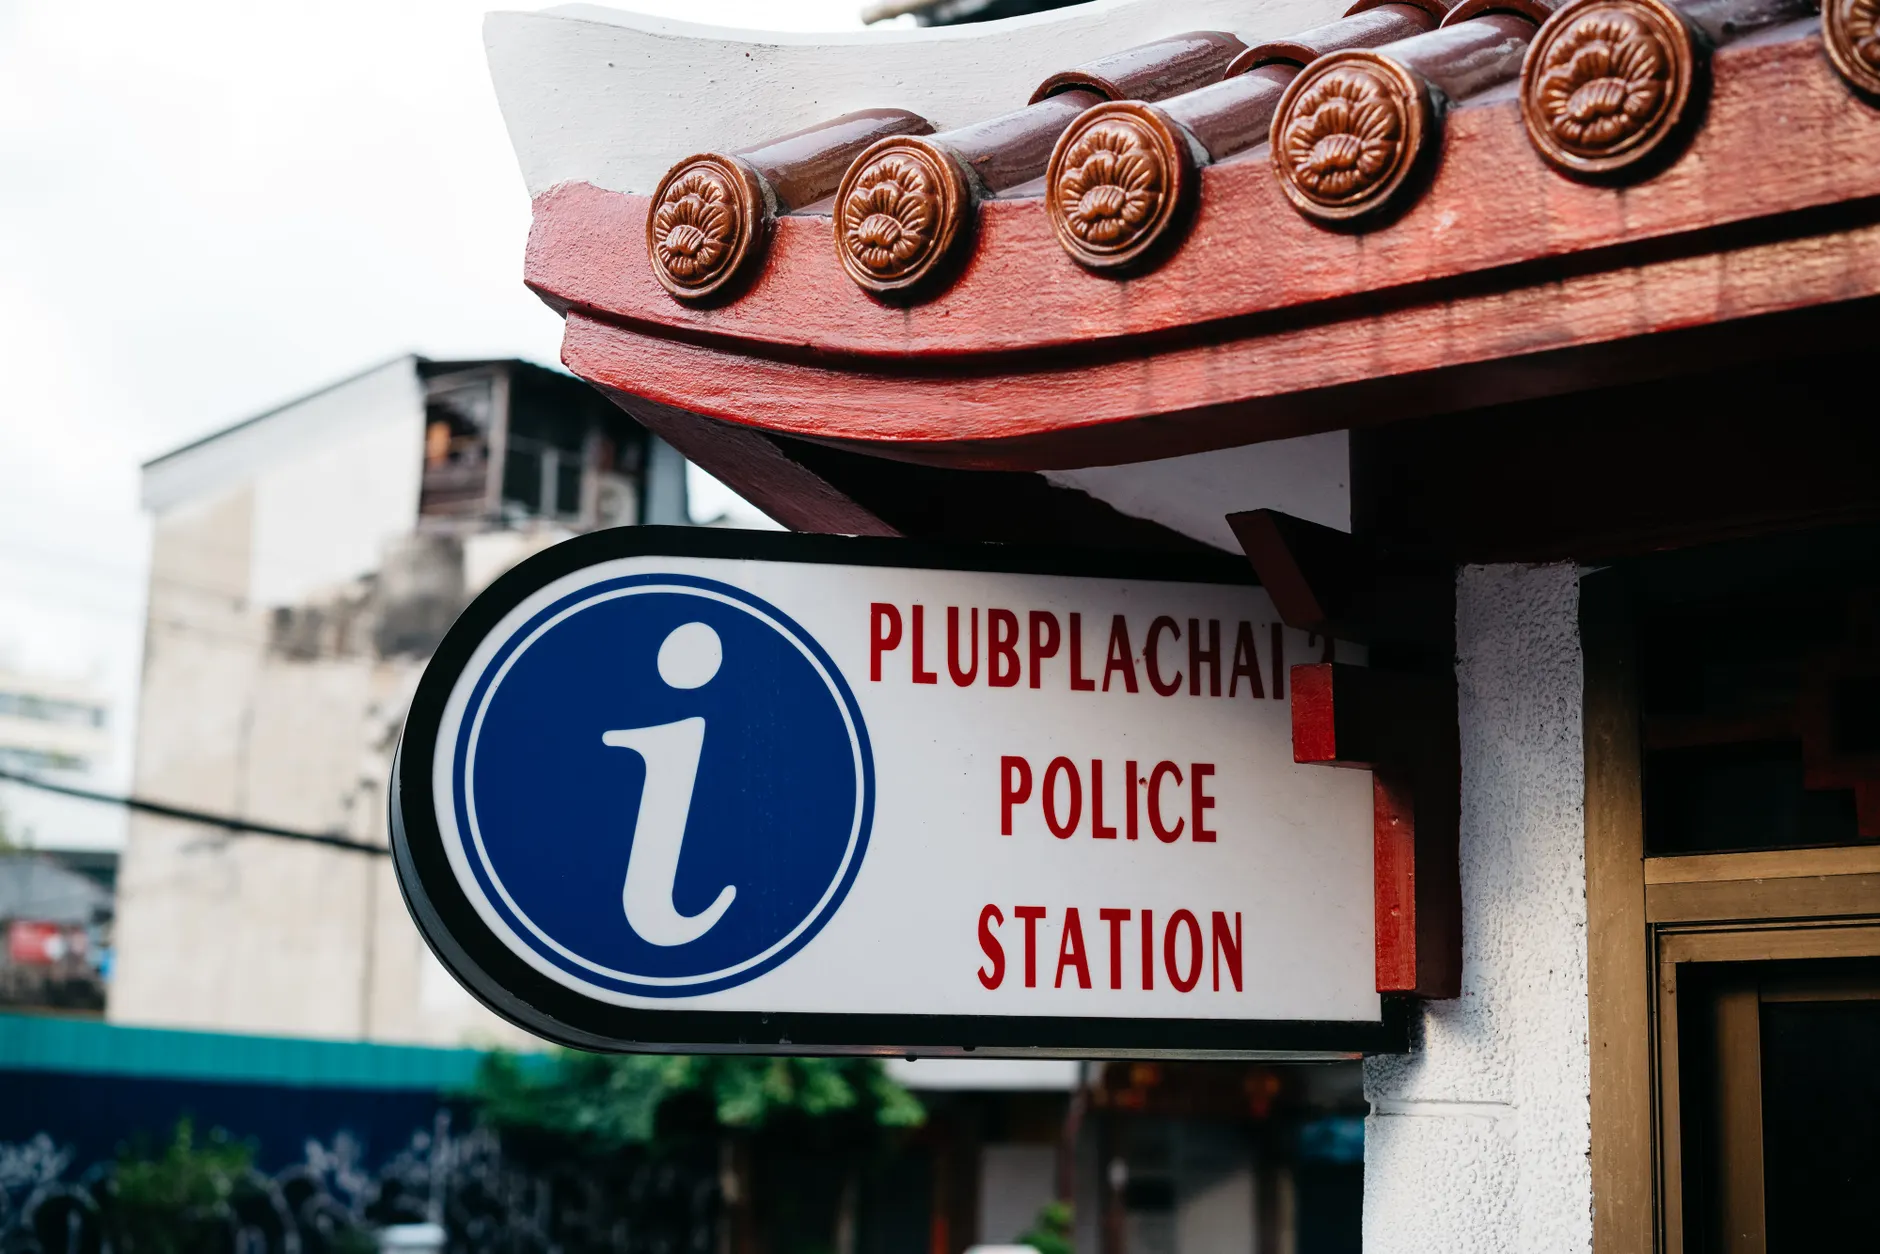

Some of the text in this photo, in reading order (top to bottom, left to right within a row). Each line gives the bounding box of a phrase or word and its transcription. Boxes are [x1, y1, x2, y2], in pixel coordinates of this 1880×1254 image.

[869, 602, 1284, 700] PLUBPLACHAI
[1001, 756, 1217, 843] POLICE
[978, 904, 1243, 993] STATION
